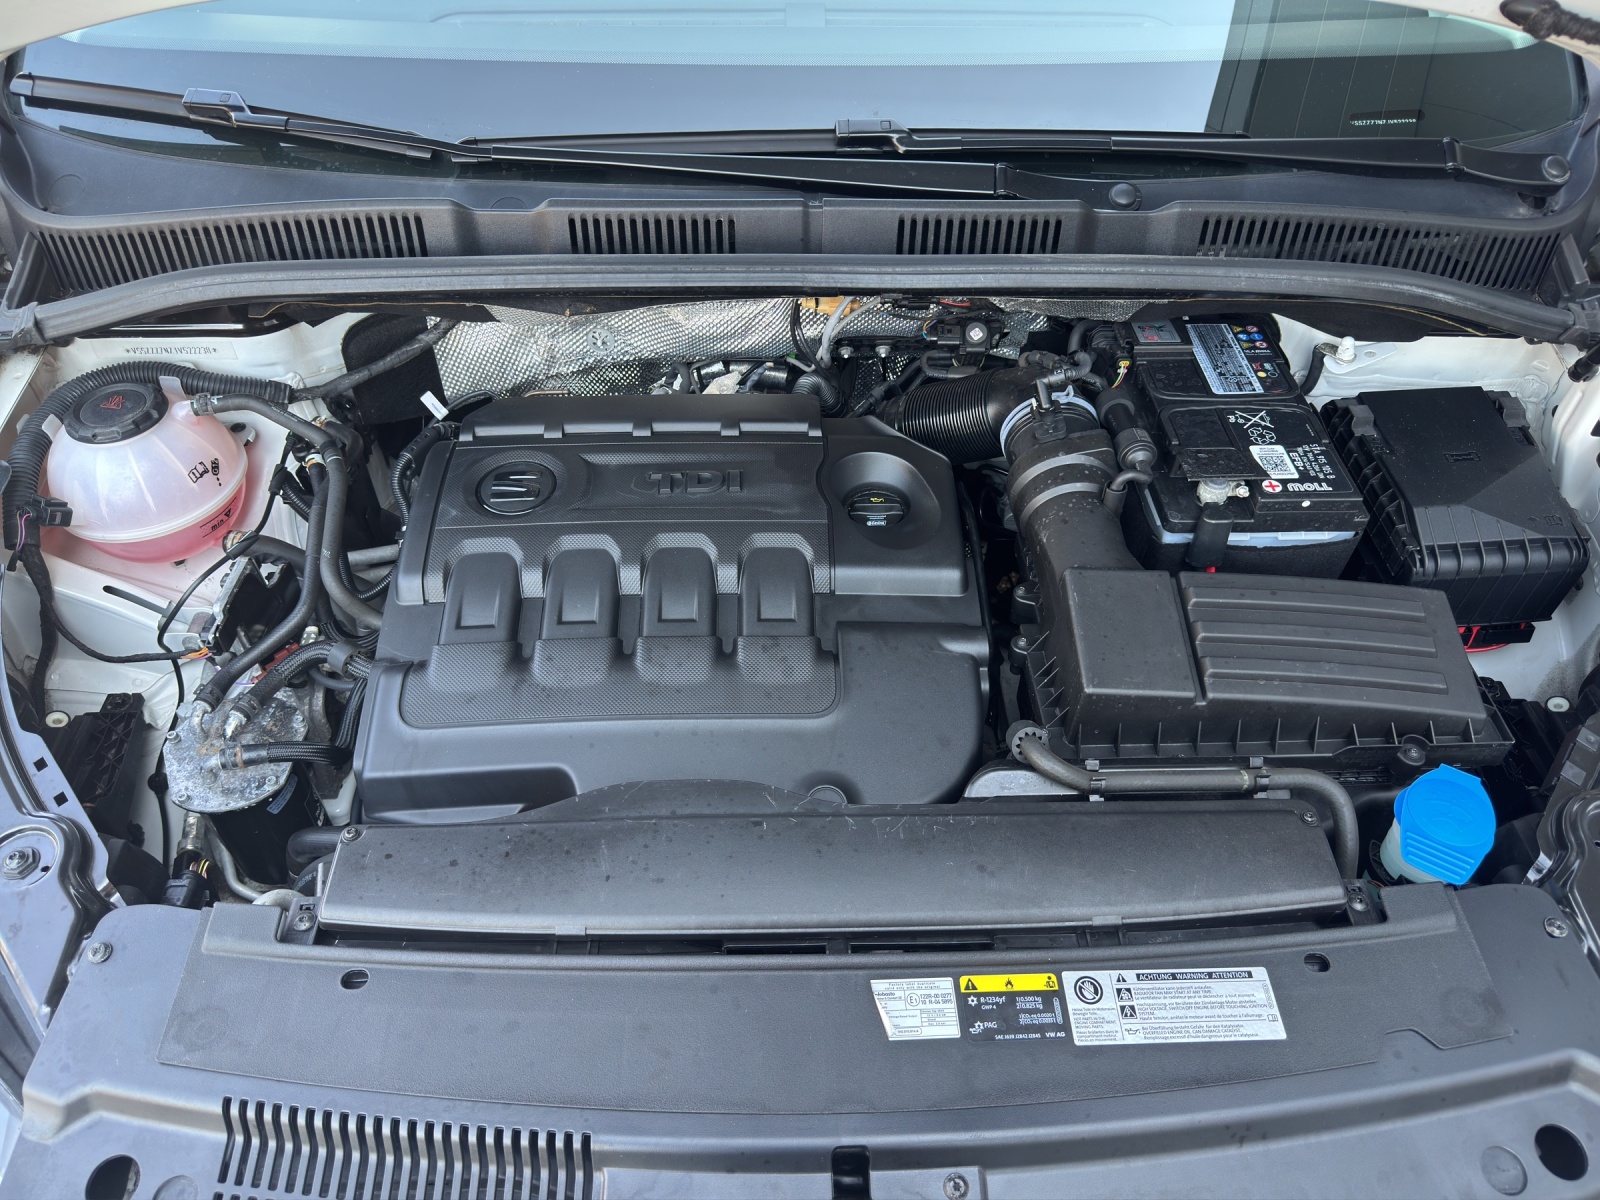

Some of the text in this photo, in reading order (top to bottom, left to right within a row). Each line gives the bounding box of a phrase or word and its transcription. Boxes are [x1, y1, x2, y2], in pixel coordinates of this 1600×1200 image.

[1289, 452, 1304, 470] EFB+
[648, 470, 743, 495] TDI
[211, 519, 224, 531] min
[1139, 971, 1249, 981] ACHTUNG WARNING ATTENTION
[980, 996, 1006, 1004] R-1234yf
